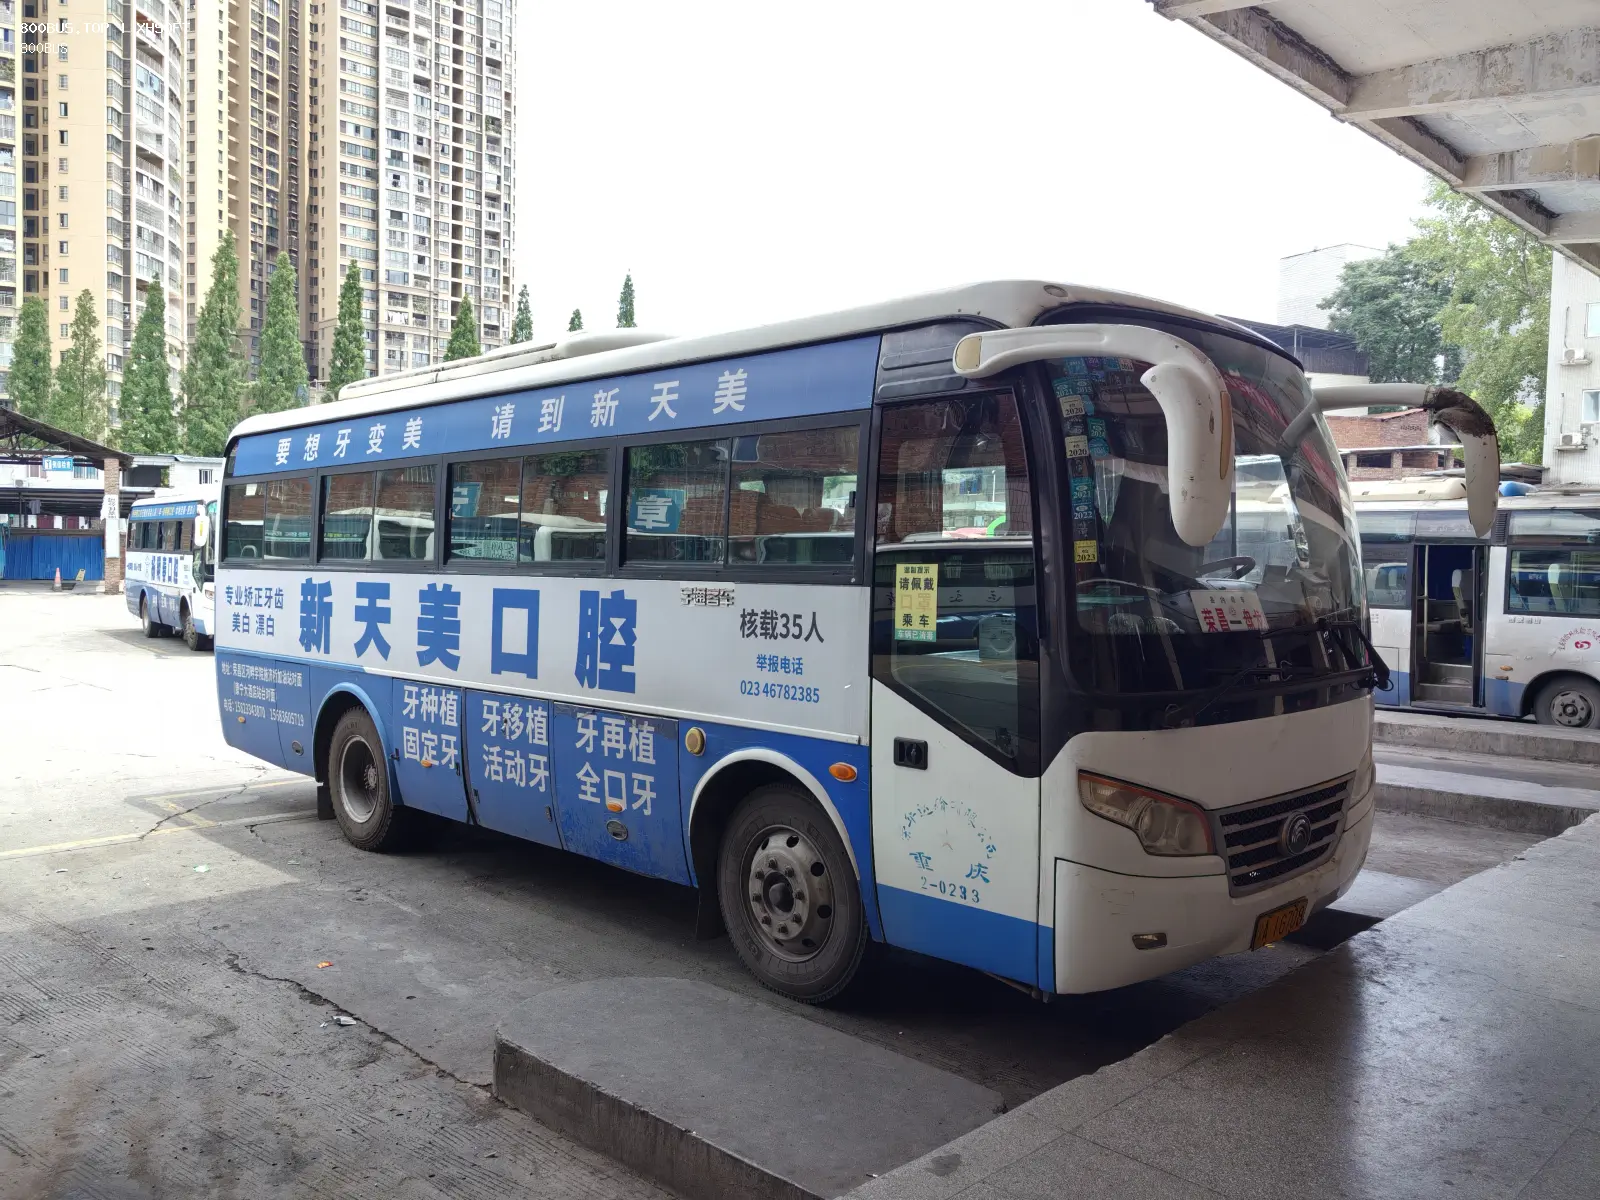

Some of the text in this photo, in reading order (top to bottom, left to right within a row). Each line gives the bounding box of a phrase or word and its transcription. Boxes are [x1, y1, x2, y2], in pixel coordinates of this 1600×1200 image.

[490, 368, 748, 440] 请到新天美
[1066, 407, 1084, 416] 2020
[275, 416, 423, 466] 要想牙变美
[1069, 447, 1088, 457] 2020
[1073, 490, 1092, 499] 2021
[1074, 511, 1093, 520] 2022
[1076, 553, 1096, 562] 2023
[899, 577, 934, 591] 请佩戴
[225, 584, 284, 610] 专业矫正牙齿
[900, 593, 932, 612] 口罩
[232, 612, 275, 637] 美白 漂白
[740, 608, 824, 643] 核载35人
[902, 613, 930, 628] 乘车
[299, 577, 637, 694] 新天美口腔
[756, 653, 804, 675] 举报电话
[740, 680, 820, 703] 023 46782385
[402, 685, 458, 727] 牙种植
[481, 699, 549, 747] 牙移植
[403, 726, 457, 770] 固定牙
[575, 712, 656, 765] 牙再植
[482, 743, 549, 793] 活动牙
[575, 762, 657, 816] 全口牙
